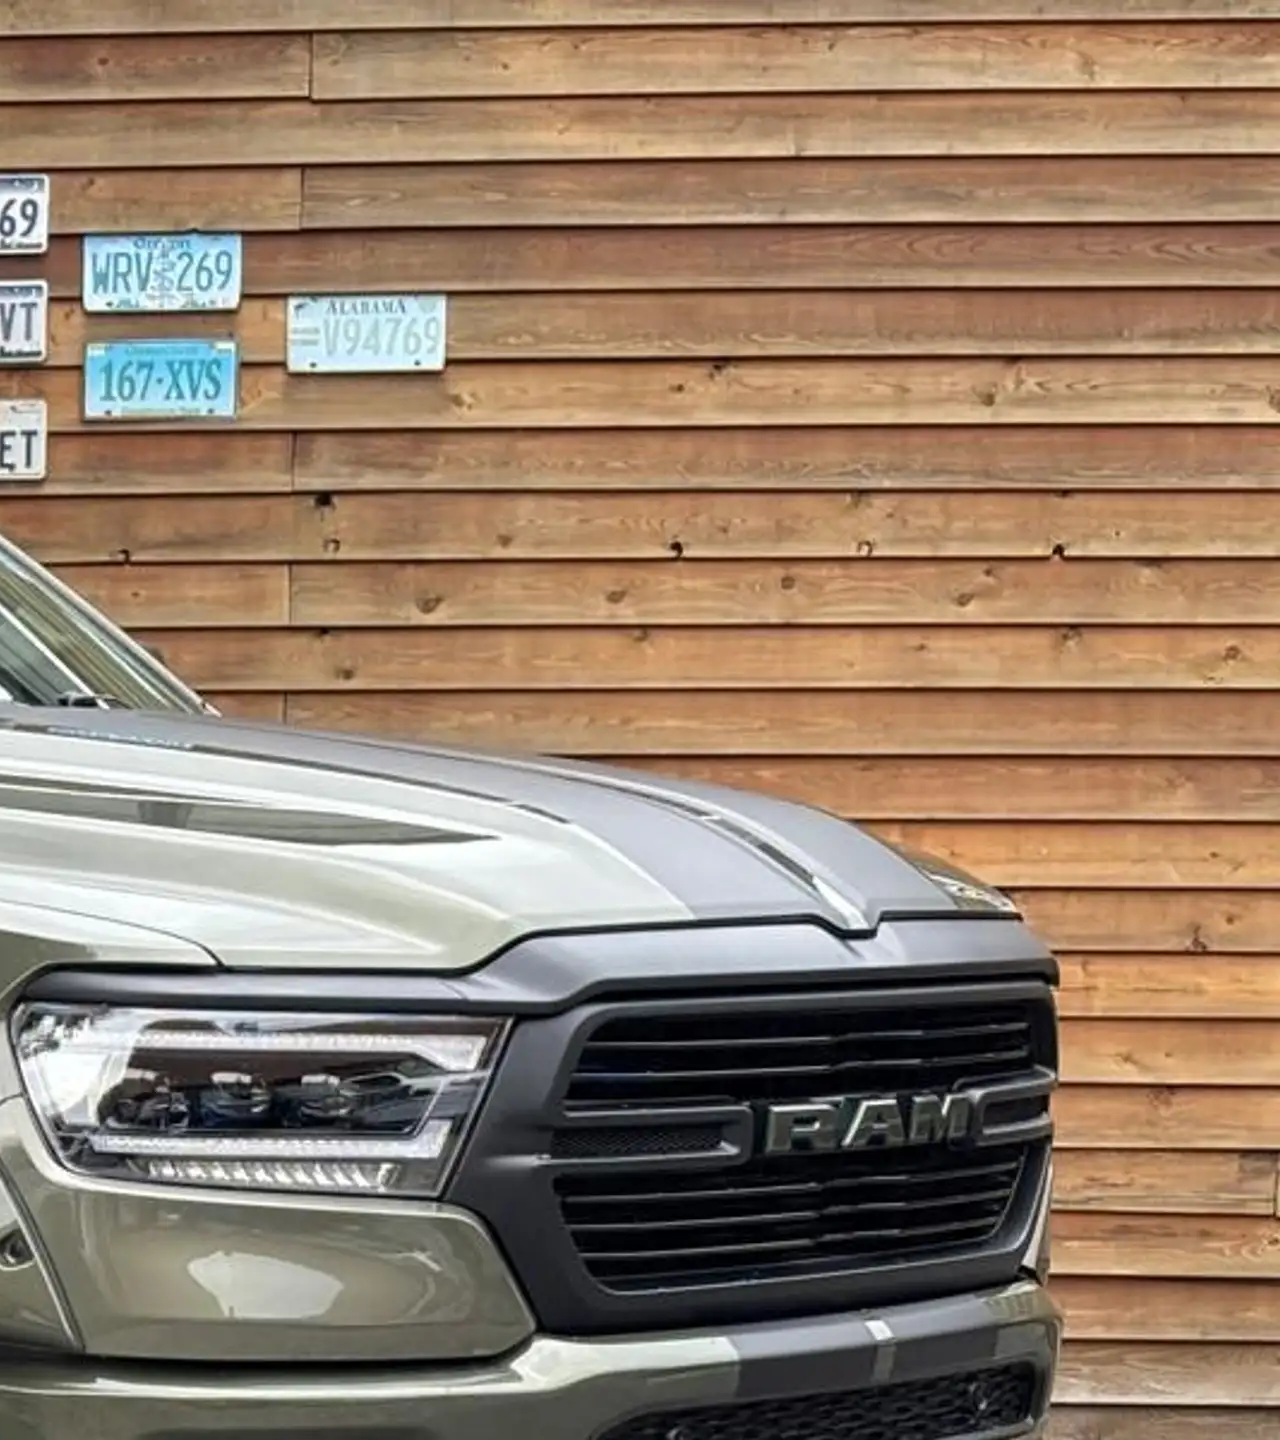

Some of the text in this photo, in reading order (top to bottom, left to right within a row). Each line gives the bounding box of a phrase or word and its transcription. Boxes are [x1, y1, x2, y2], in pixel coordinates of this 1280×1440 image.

[91, 250, 233, 294] WRV 269
[765, 1093, 970, 1154] RAM
